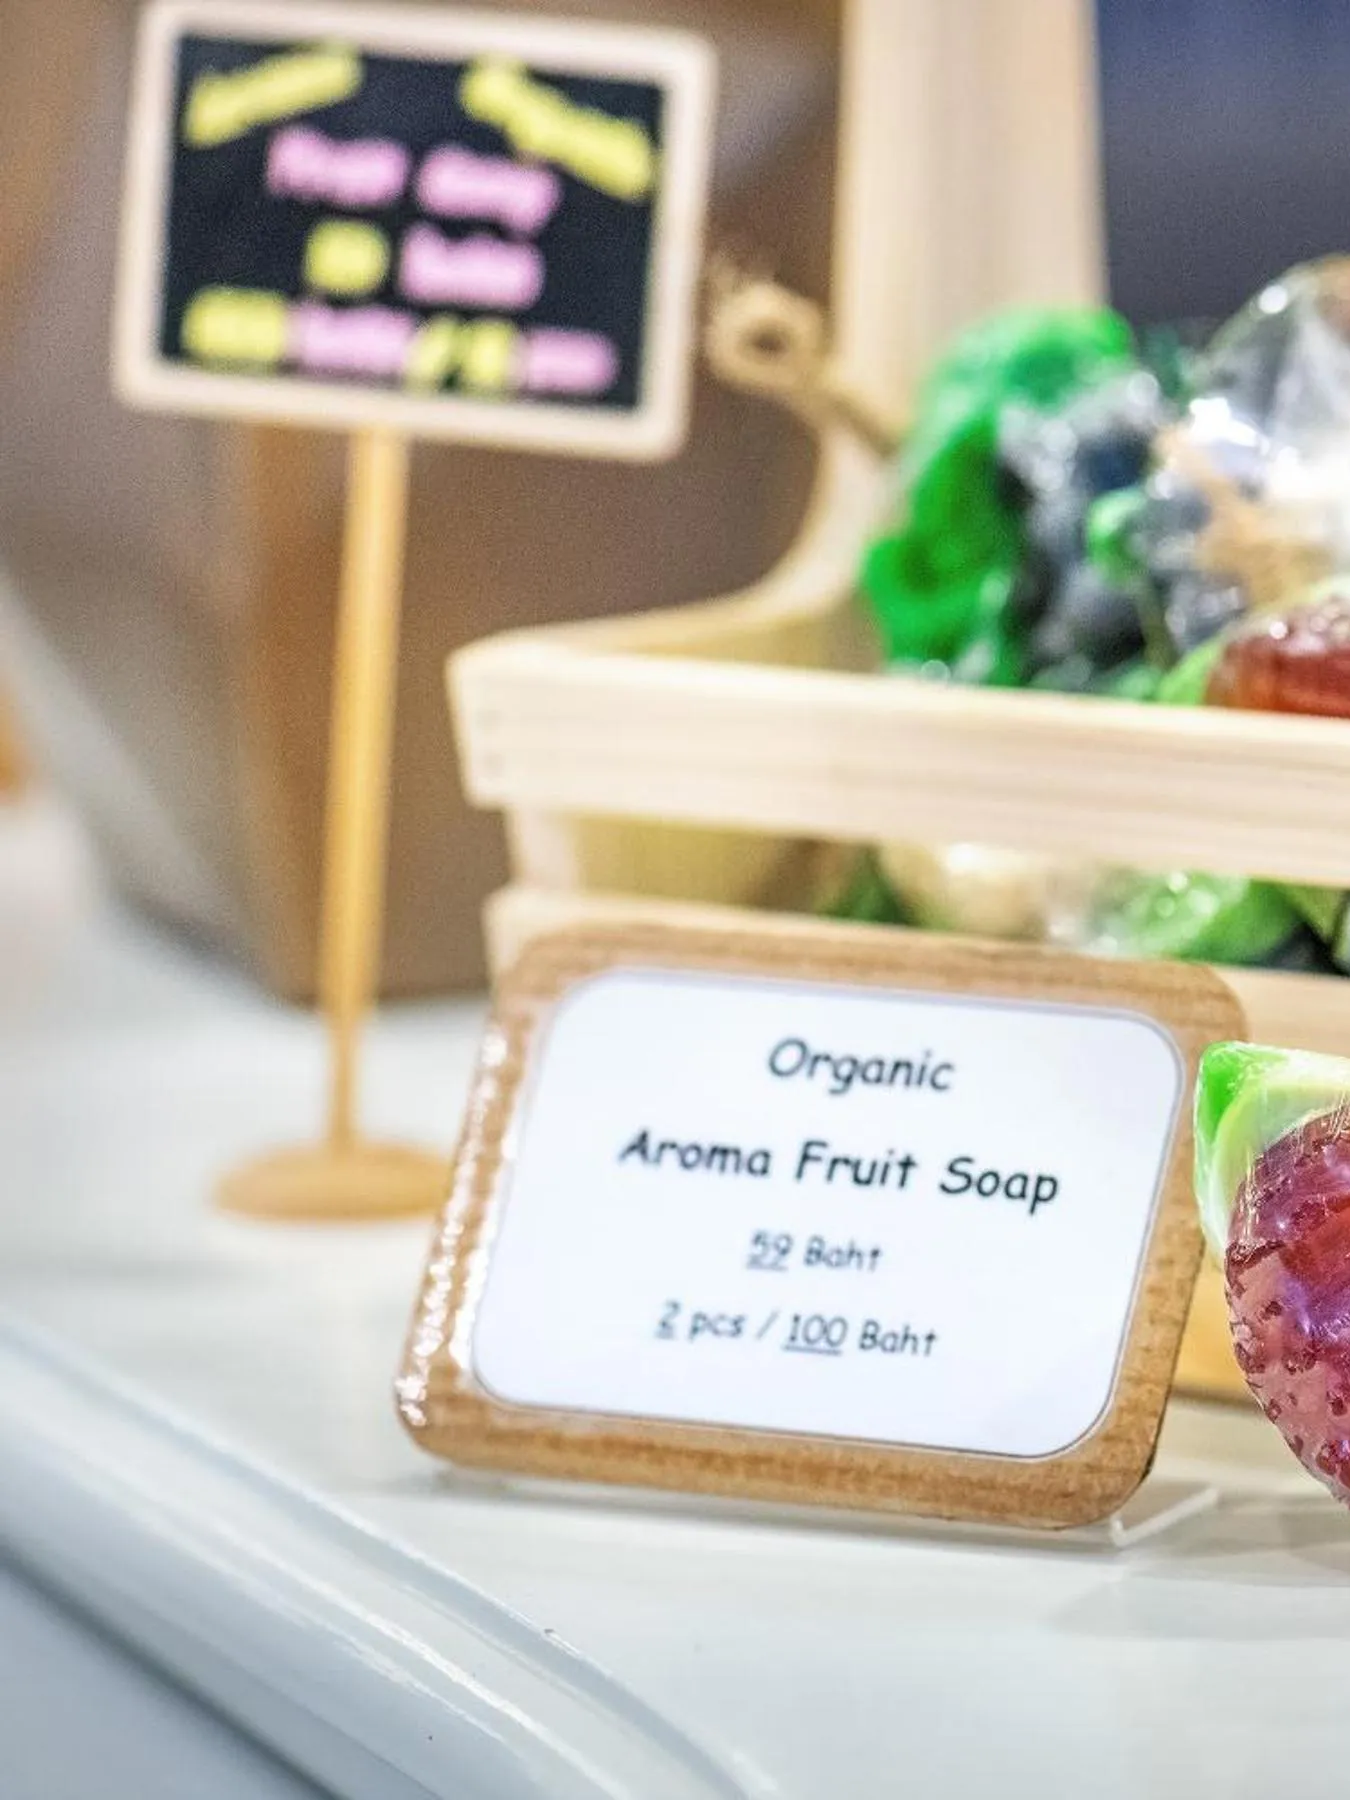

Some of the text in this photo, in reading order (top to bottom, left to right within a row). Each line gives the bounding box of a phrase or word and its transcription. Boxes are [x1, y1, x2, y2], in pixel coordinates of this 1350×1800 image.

[768, 1037, 956, 1096] Organic
[618, 1129, 1060, 1216] Aroma Fruit Soap
[746, 1229, 883, 1272] 59 Baht
[656, 1299, 938, 1357] 2 pcs / 100 Baht
